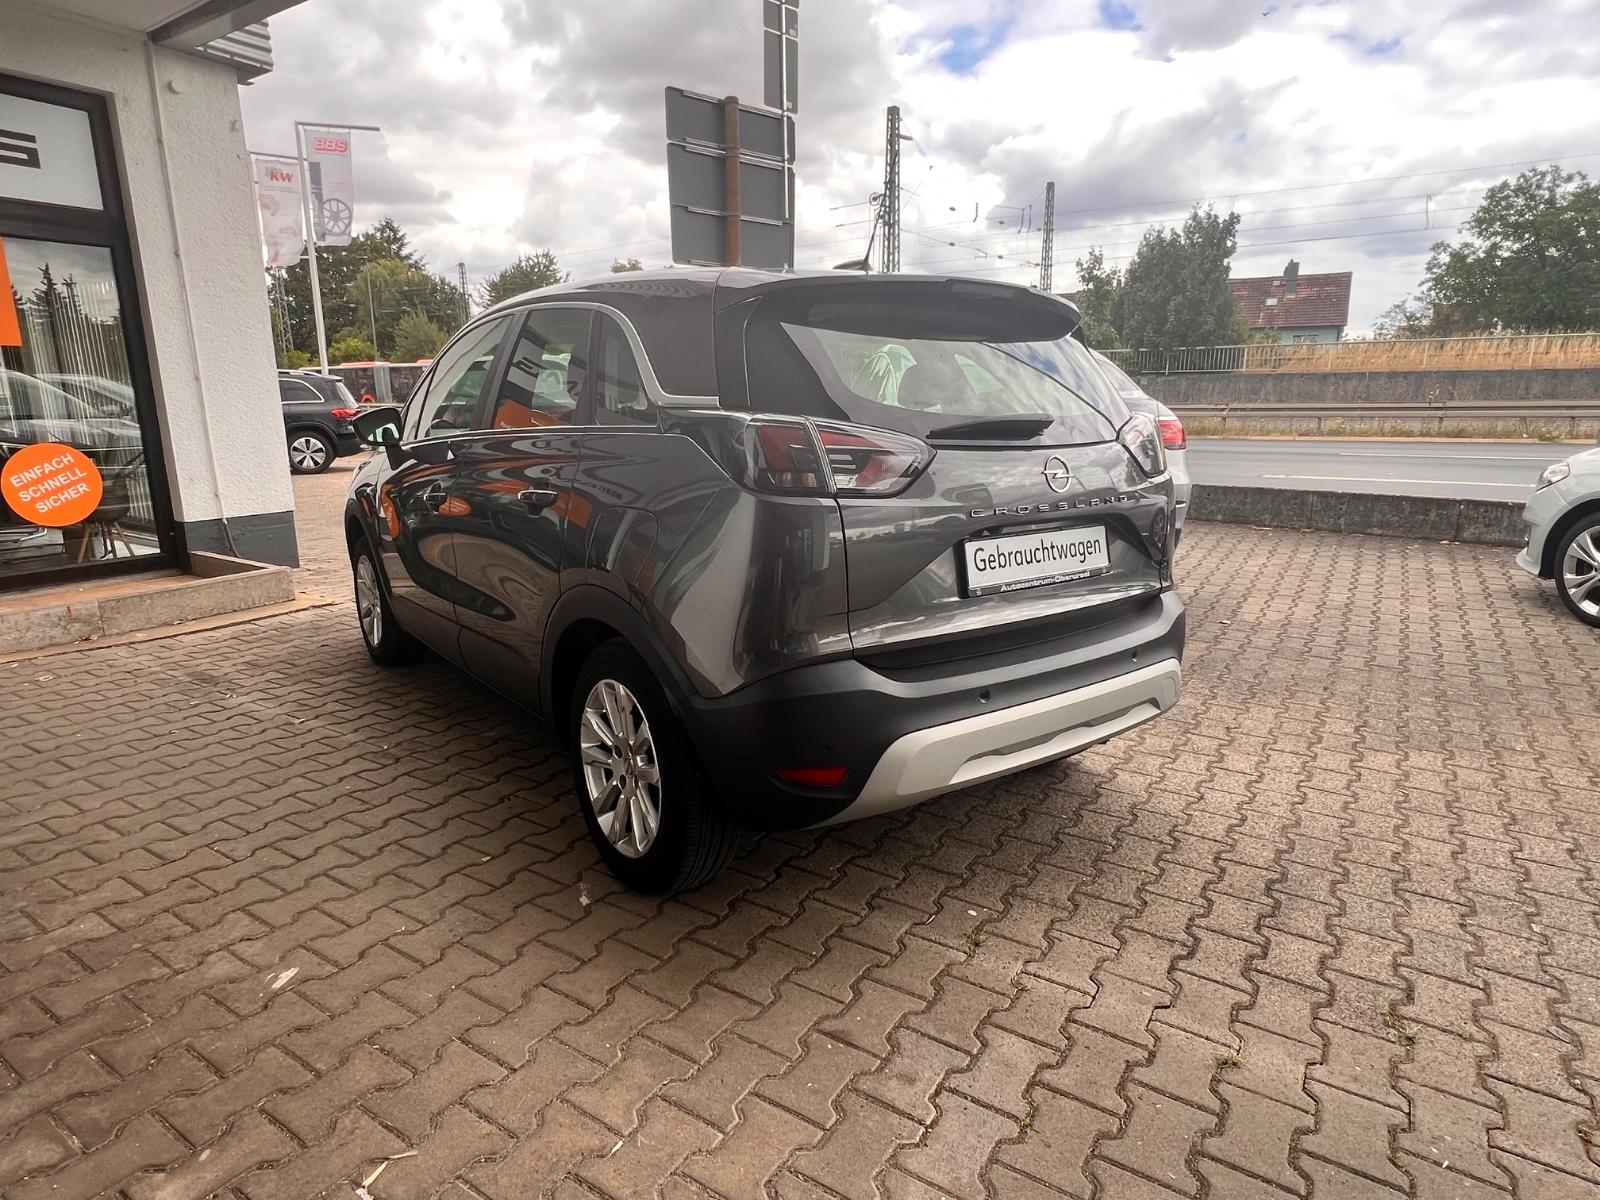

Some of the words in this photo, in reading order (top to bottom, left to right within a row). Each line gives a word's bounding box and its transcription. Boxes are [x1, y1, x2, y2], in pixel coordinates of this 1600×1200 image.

[314, 137, 348, 153] BBS
[269, 170, 294, 183] KW
[9, 453, 75, 488] EINFACH
[18, 467, 88, 502] SCHNELL
[35, 482, 91, 513] SICHER
[970, 495, 1128, 518] CROSSLAND
[974, 539, 1102, 572] Gebrauchtwagen
[1000, 571, 1091, 592] Autozentrum-Oberursel
